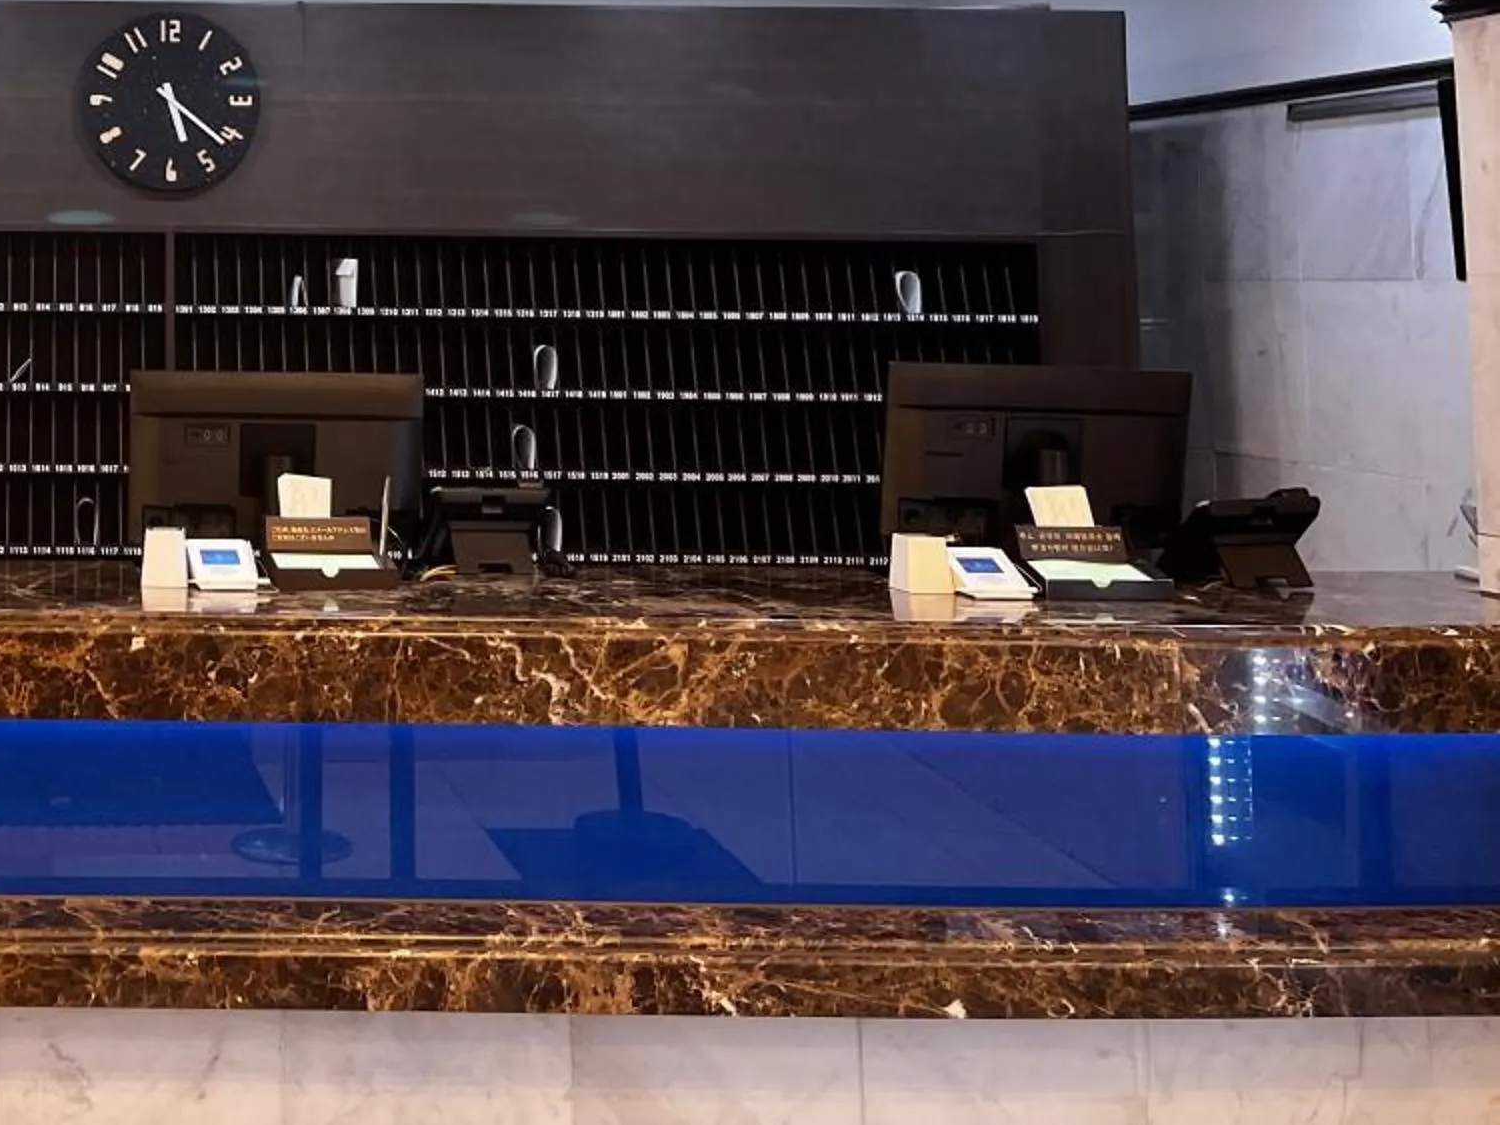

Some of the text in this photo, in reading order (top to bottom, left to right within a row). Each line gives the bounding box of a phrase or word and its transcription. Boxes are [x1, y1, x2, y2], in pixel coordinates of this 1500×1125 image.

[124, 27, 148, 54] 11
[160, 19, 181, 43] 12
[198, 29, 213, 51] 1
[219, 56, 243, 76] 2
[89, 93, 113, 106] 9
[228, 94, 253, 106] 3
[219, 125, 244, 142] 4
[128, 148, 147, 172] 7
[164, 156, 178, 183] 6
[196, 148, 217, 173] 5
